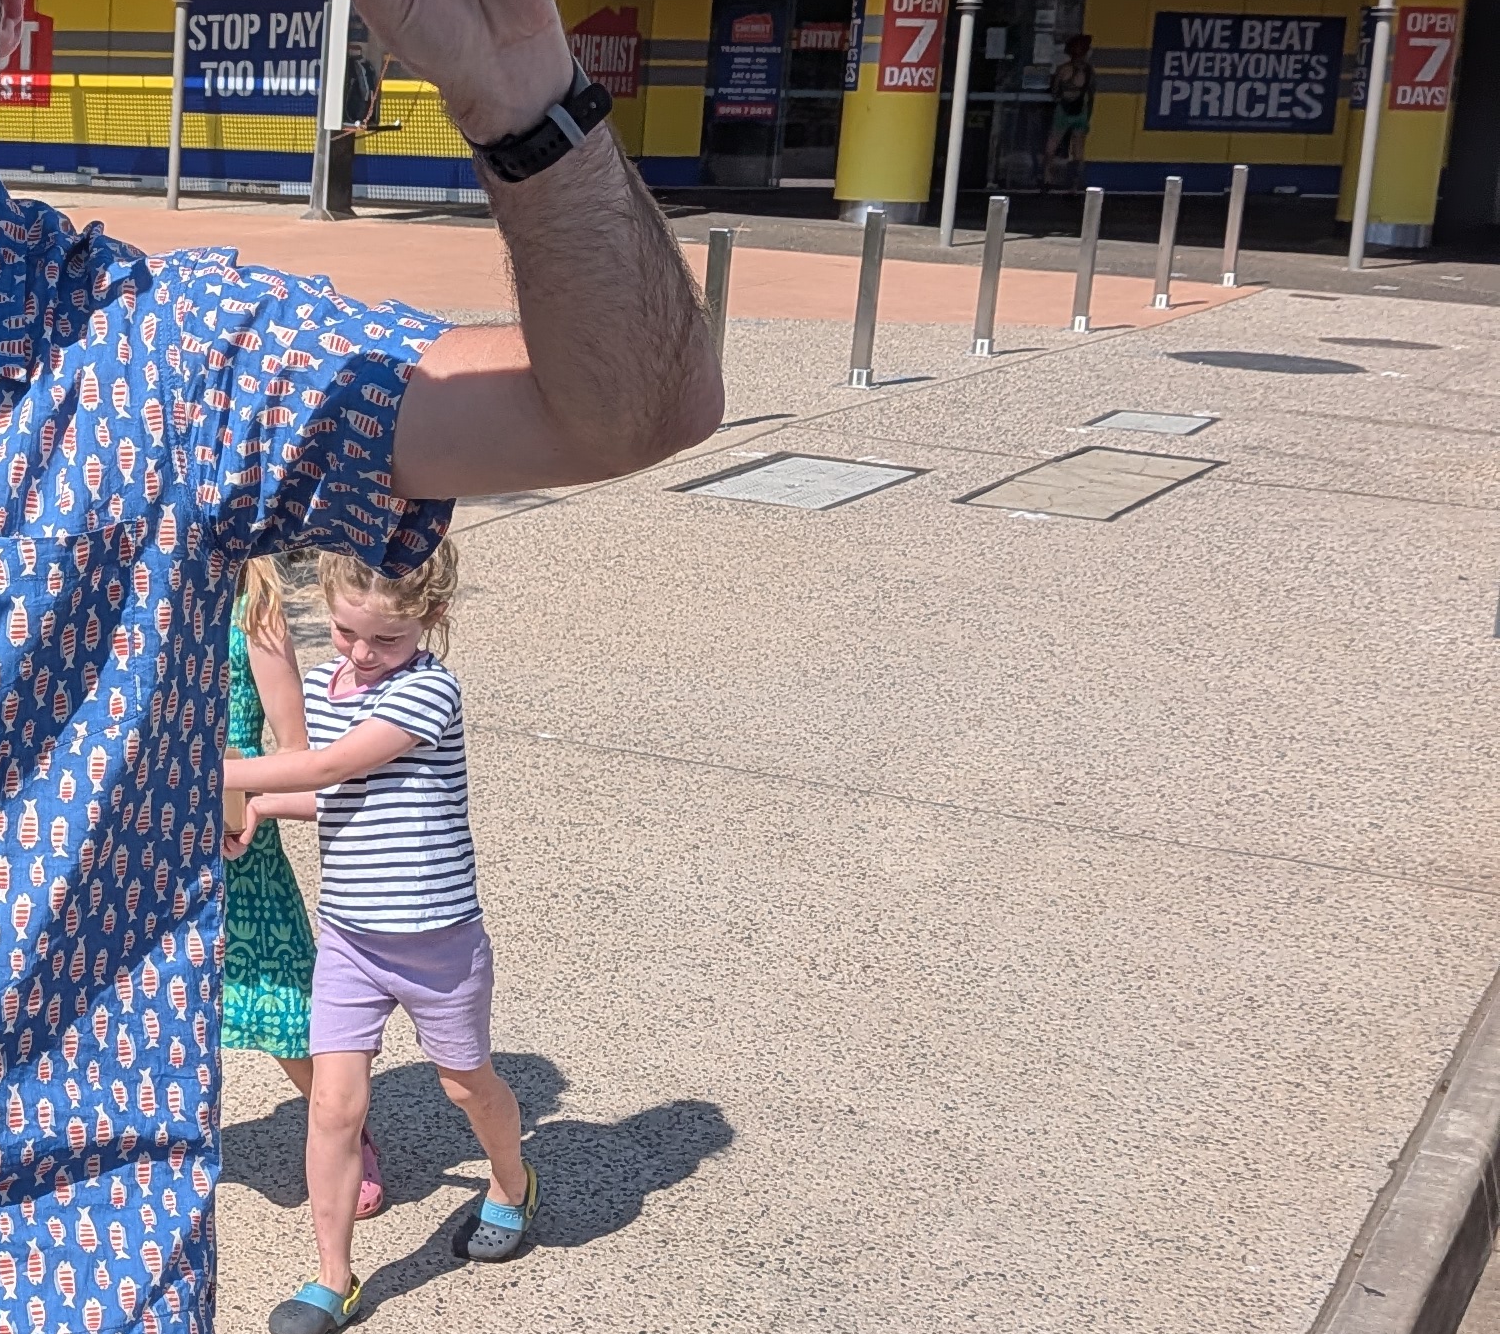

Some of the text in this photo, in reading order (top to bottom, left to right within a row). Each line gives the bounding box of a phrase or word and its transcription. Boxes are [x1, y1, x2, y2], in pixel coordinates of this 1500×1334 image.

[189, 11, 325, 50] STOP PAY
[800, 30, 843, 49] ENTRY
[895, 18, 938, 63] 7
[1181, 18, 1322, 52] WE BEAT
[1406, 12, 1455, 33] OPEN
[571, 33, 637, 73] CHEMIST
[1163, 50, 1329, 81] EVERYONE'S
[1408, 37, 1451, 82] 7
[201, 59, 324, 97] TOO MUC
[884, 66, 936, 87] DAYS!
[719, 106, 742, 115] OPEN
[1158, 79, 1325, 120] PRICES
